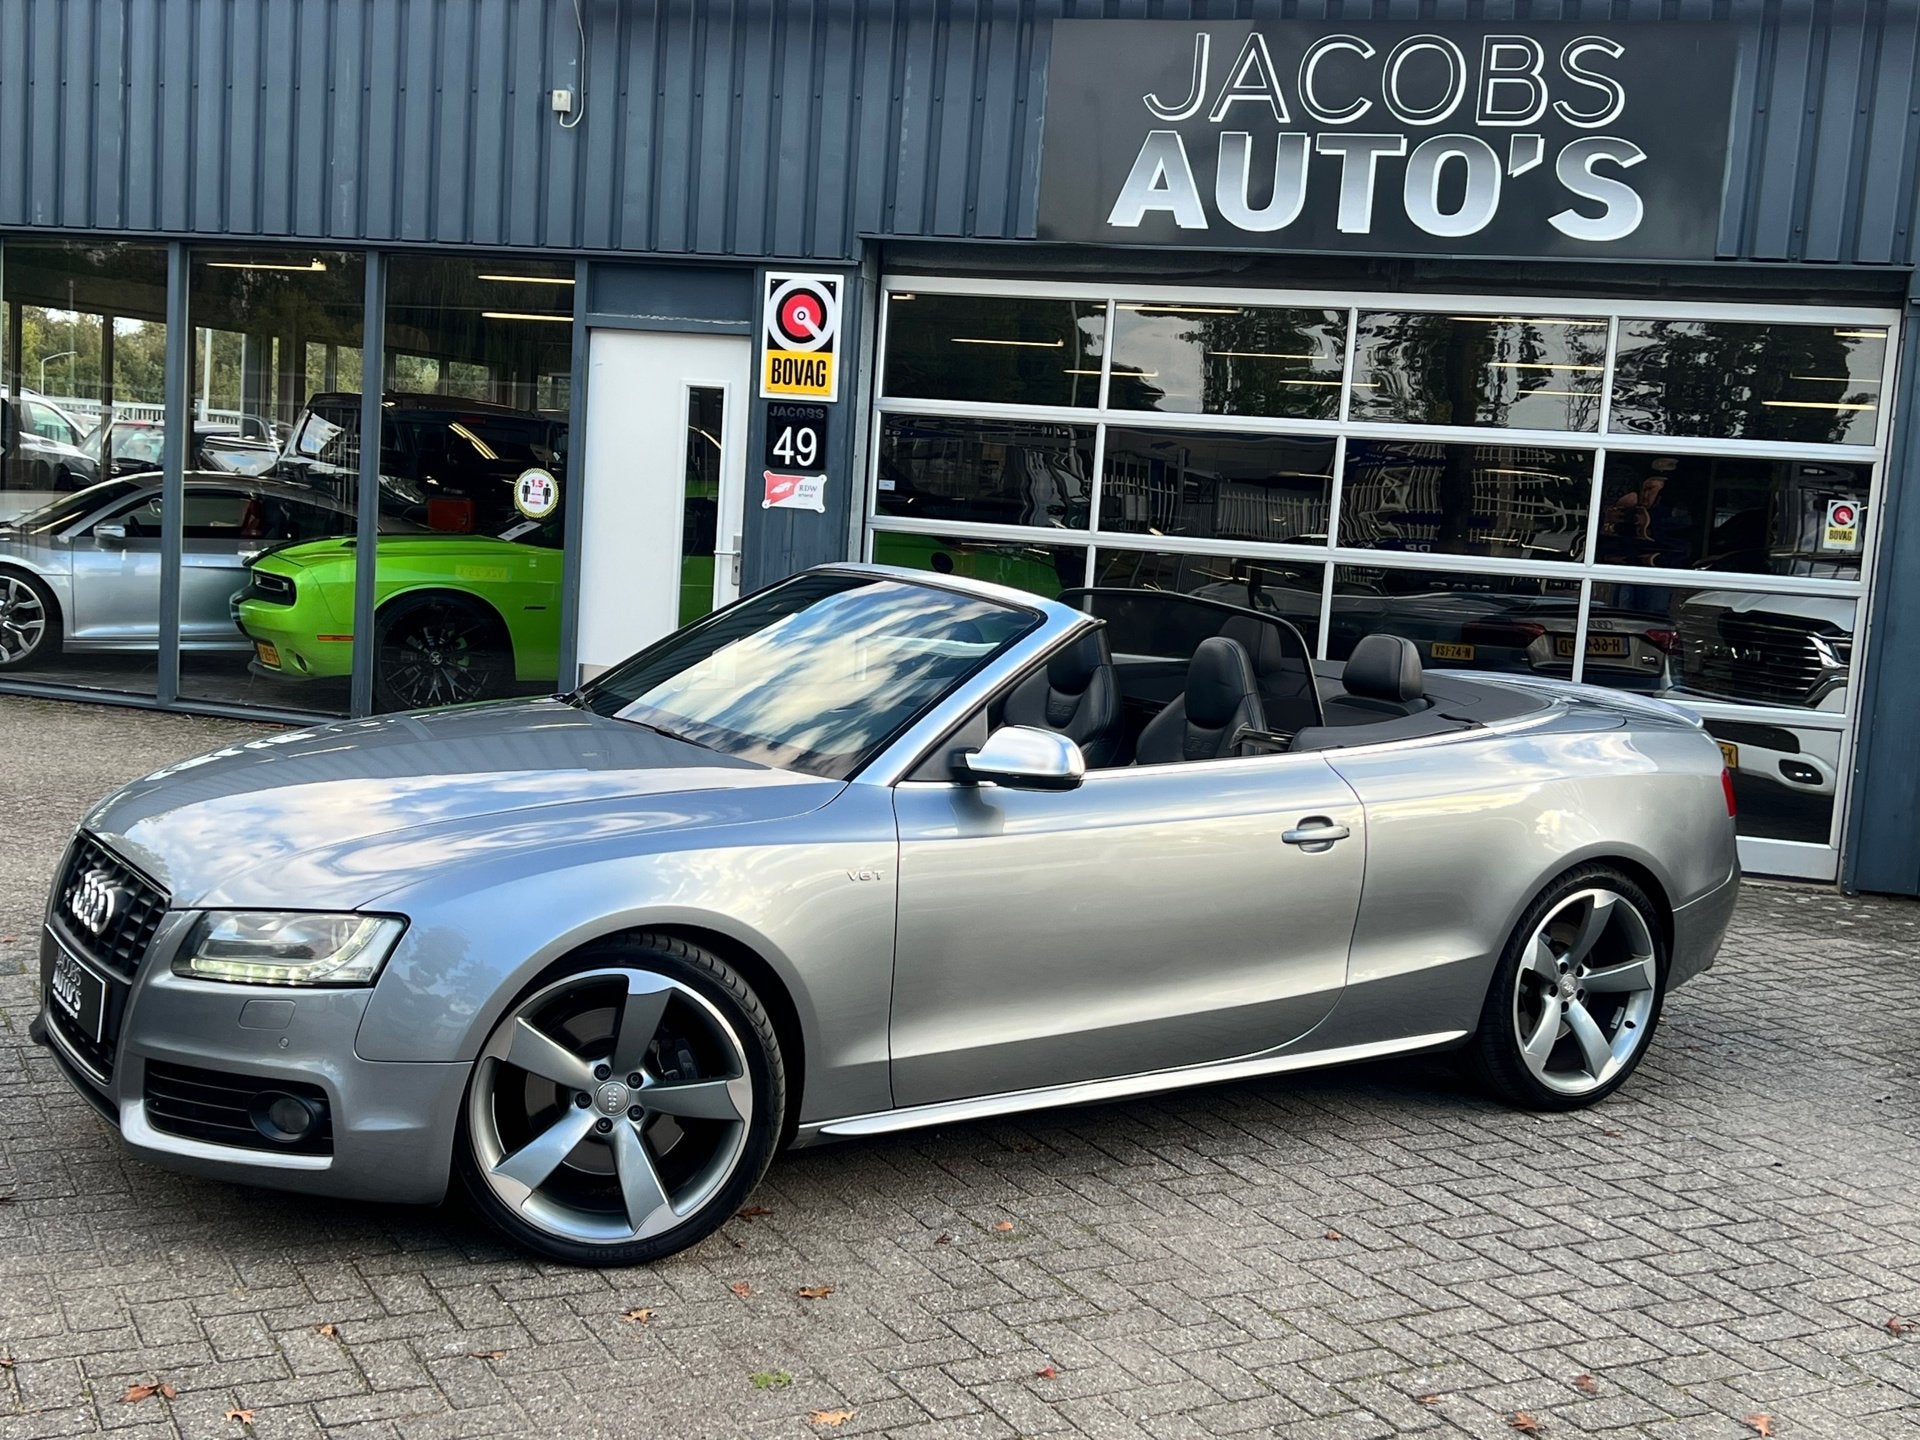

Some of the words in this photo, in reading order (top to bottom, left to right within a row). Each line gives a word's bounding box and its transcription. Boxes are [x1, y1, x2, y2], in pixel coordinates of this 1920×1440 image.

[1142, 32, 1626, 128] JACOBS
[1106, 130, 1648, 242] AUTO'S
[771, 357, 827, 387] BOVAG
[769, 405, 825, 419] JACOBS
[772, 426, 817, 467] 49
[799, 484, 818, 493] RDW
[1829, 529, 1853, 541] BOVAG
[846, 870, 885, 882] V6T
